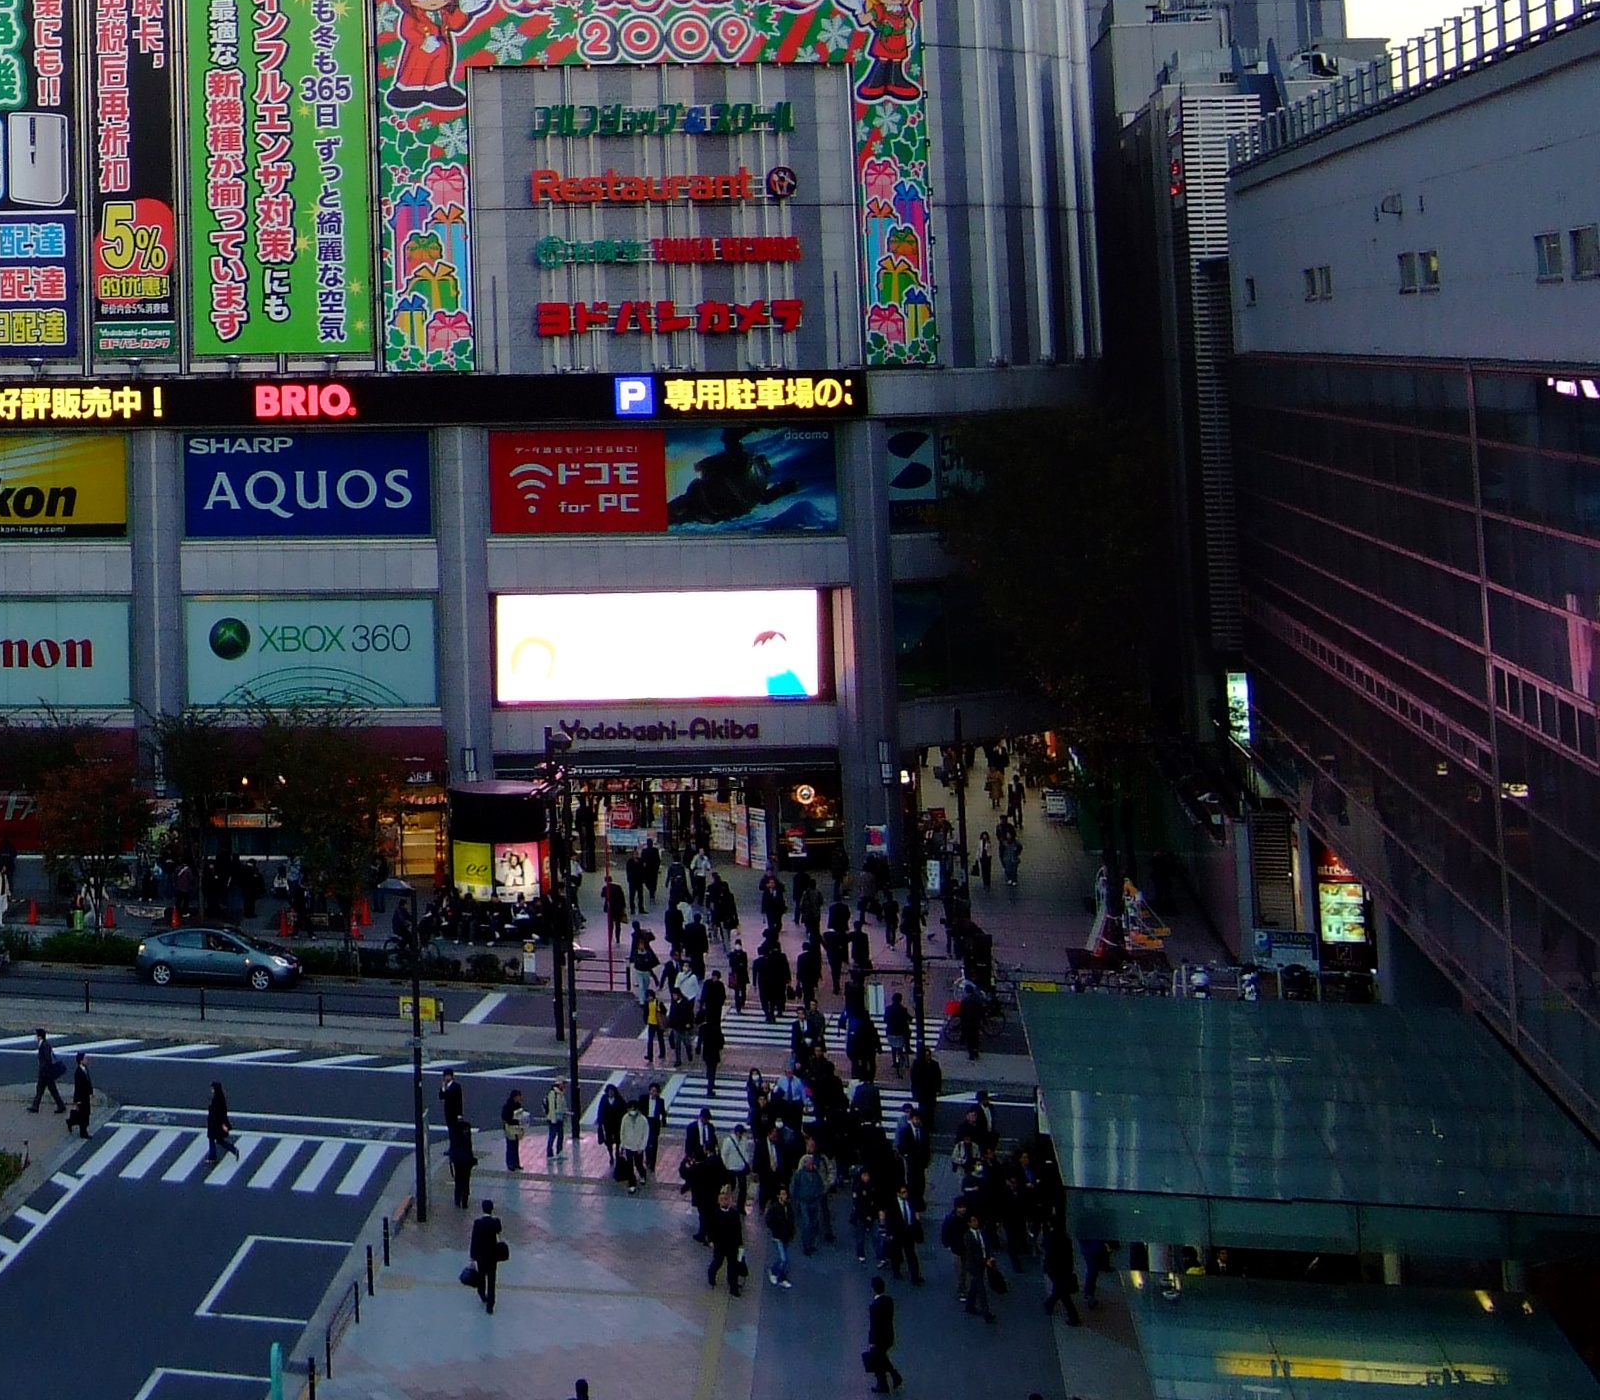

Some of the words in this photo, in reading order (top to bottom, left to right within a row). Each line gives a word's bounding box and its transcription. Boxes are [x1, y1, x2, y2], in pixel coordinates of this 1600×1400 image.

[578, 13, 752, 61] 2009
[531, 166, 754, 203] Restaurant
[102, 201, 167, 272] 5%
[537, 299, 803, 337] ヨドバシカメラ
[255, 384, 354, 419] BRIO
[618, 380, 648, 410] P
[188, 436, 295, 455] SHARP
[783, 428, 830, 441] docomo
[556, 461, 640, 487] ドコモ
[203, 468, 415, 518] AQUOS
[557, 499, 591, 515] for
[597, 492, 641, 514] PC
[258, 625, 347, 653] XBOX
[351, 623, 412, 653] 360
[559, 716, 760, 742] Yodobashi-Akiba
